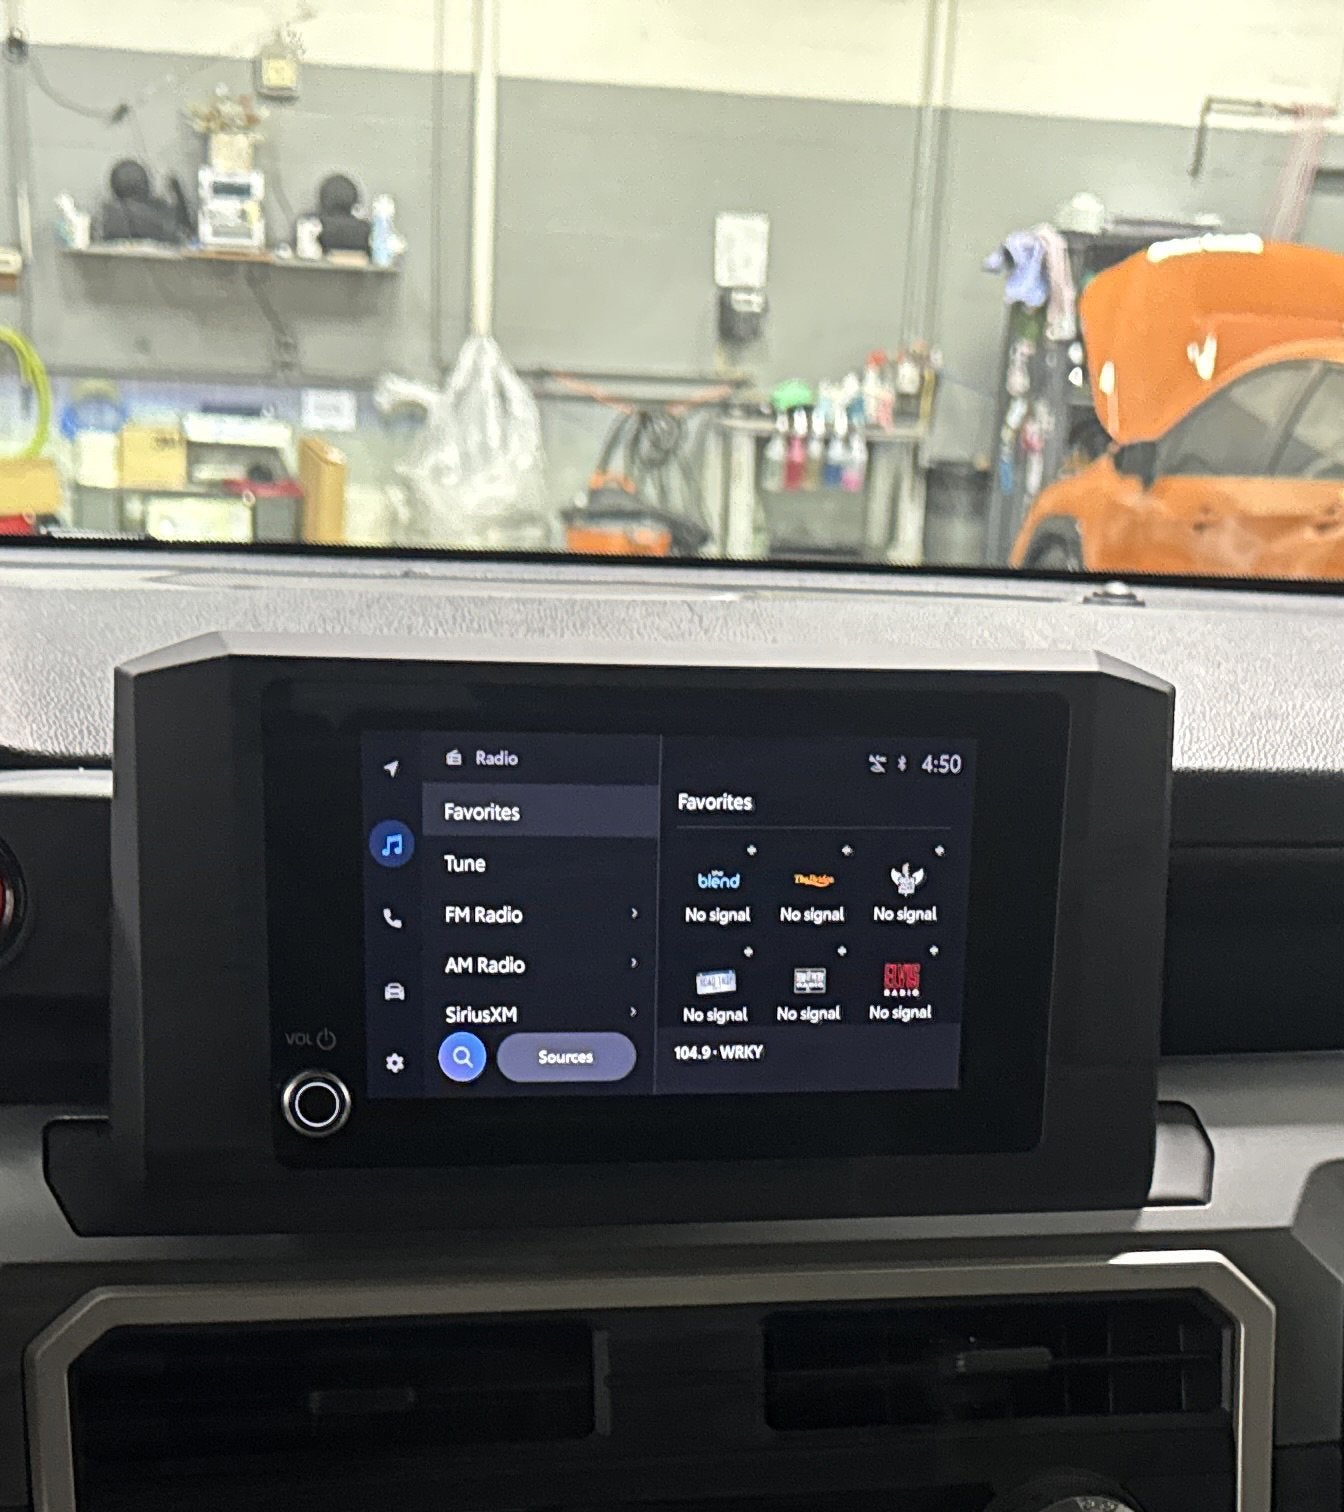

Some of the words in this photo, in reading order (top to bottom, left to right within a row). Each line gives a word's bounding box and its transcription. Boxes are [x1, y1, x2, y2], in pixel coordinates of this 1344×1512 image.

[475, 750, 519, 766] Radio
[922, 754, 962, 774] 4:50
[678, 793, 753, 811] Favorites
[444, 802, 521, 821] Favorites
[444, 855, 486, 873] Tune
[697, 872, 741, 890] blend
[444, 906, 470, 923] FM
[474, 906, 523, 924] Radio
[685, 907, 707, 922] No
[709, 906, 751, 925] signal
[780, 907, 801, 922] No
[803, 906, 845, 925] signal
[873, 906, 894, 921] No
[896, 906, 937, 924] signal
[444, 957, 473, 974] AM
[477, 956, 526, 974] Radio
[444, 1006, 518, 1024] SiriusXM
[683, 1007, 705, 1022] No
[706, 1006, 748, 1025] signal
[777, 1006, 798, 1021] No
[799, 1005, 841, 1024] signal
[869, 1005, 889, 1020] No
[891, 1004, 933, 1023] signal
[284, 1032, 313, 1046] VOL
[537, 1049, 594, 1065] Sources
[674, 1045, 712, 1060] 104.9
[719, 1044, 764, 1060] WRKY
